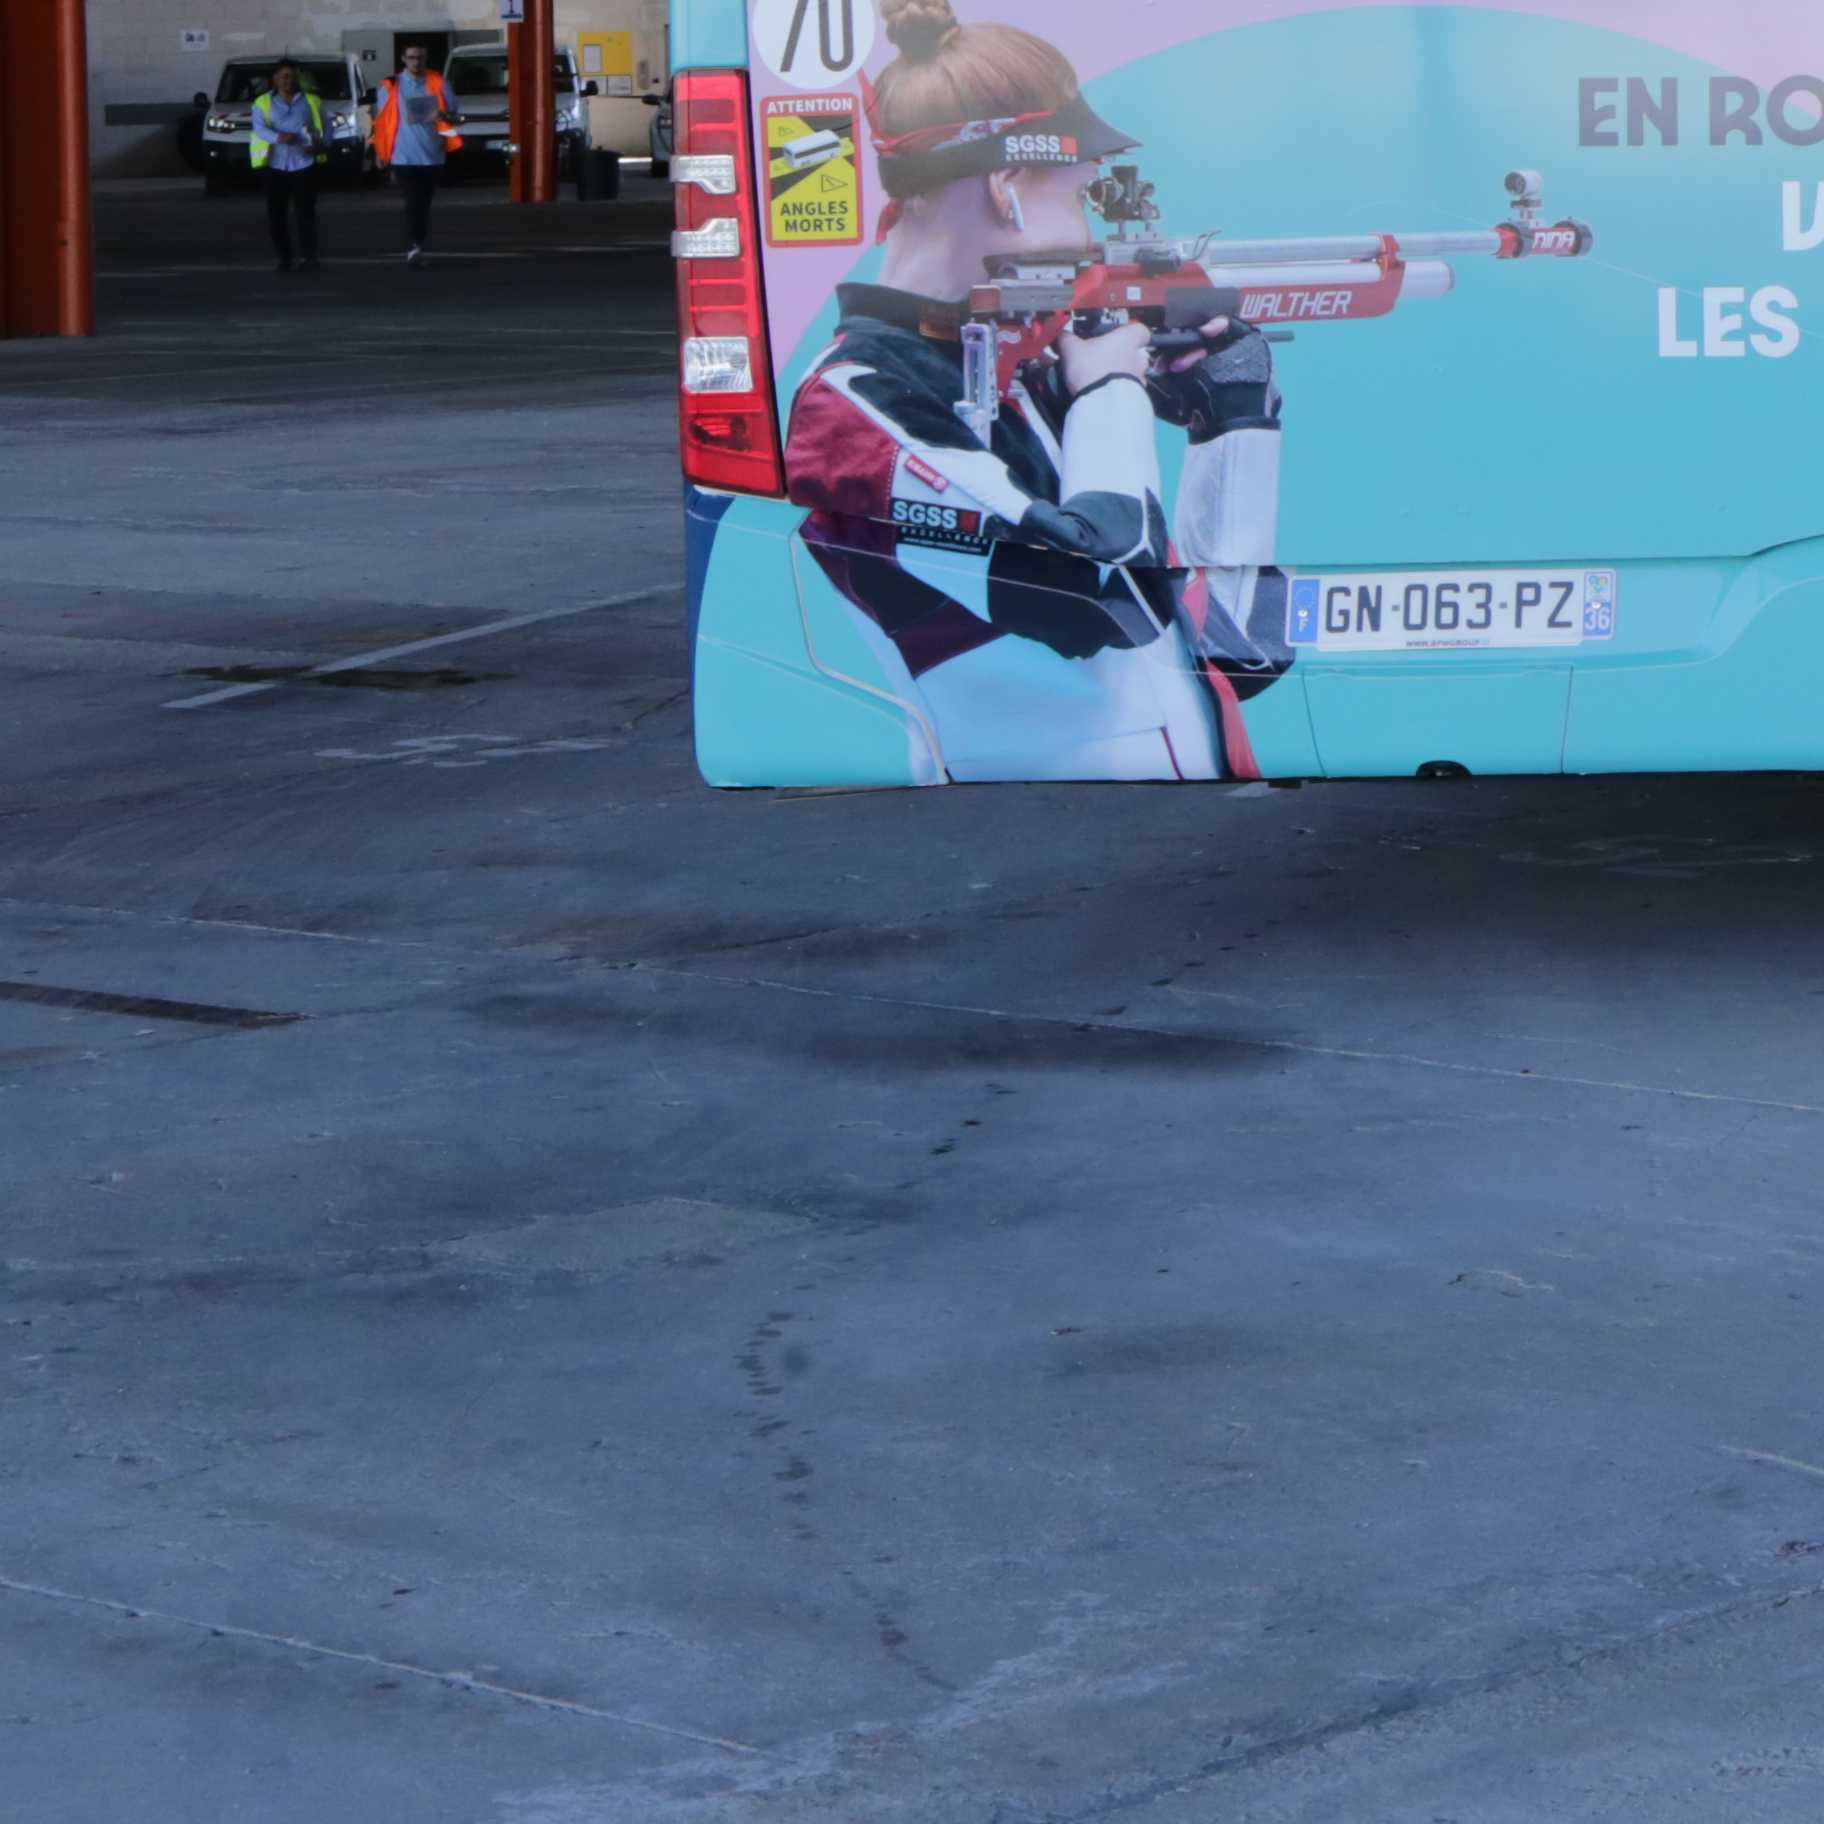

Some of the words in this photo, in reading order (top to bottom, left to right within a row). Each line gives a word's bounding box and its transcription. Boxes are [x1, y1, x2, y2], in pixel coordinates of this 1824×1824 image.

[768, 98, 852, 113] ATTENTION
[1578, 75, 1679, 147] EN
[1005, 134, 1060, 153] SGSS
[780, 201, 848, 216] ANGLES
[785, 219, 846, 232] MORTS
[1240, 290, 1353, 318] WALTHER
[1658, 285, 1798, 359] LES
[893, 501, 957, 529] SGSS
[1325, 581, 1575, 633] GN-063-PZ
[1584, 609, 1610, 631] 36
